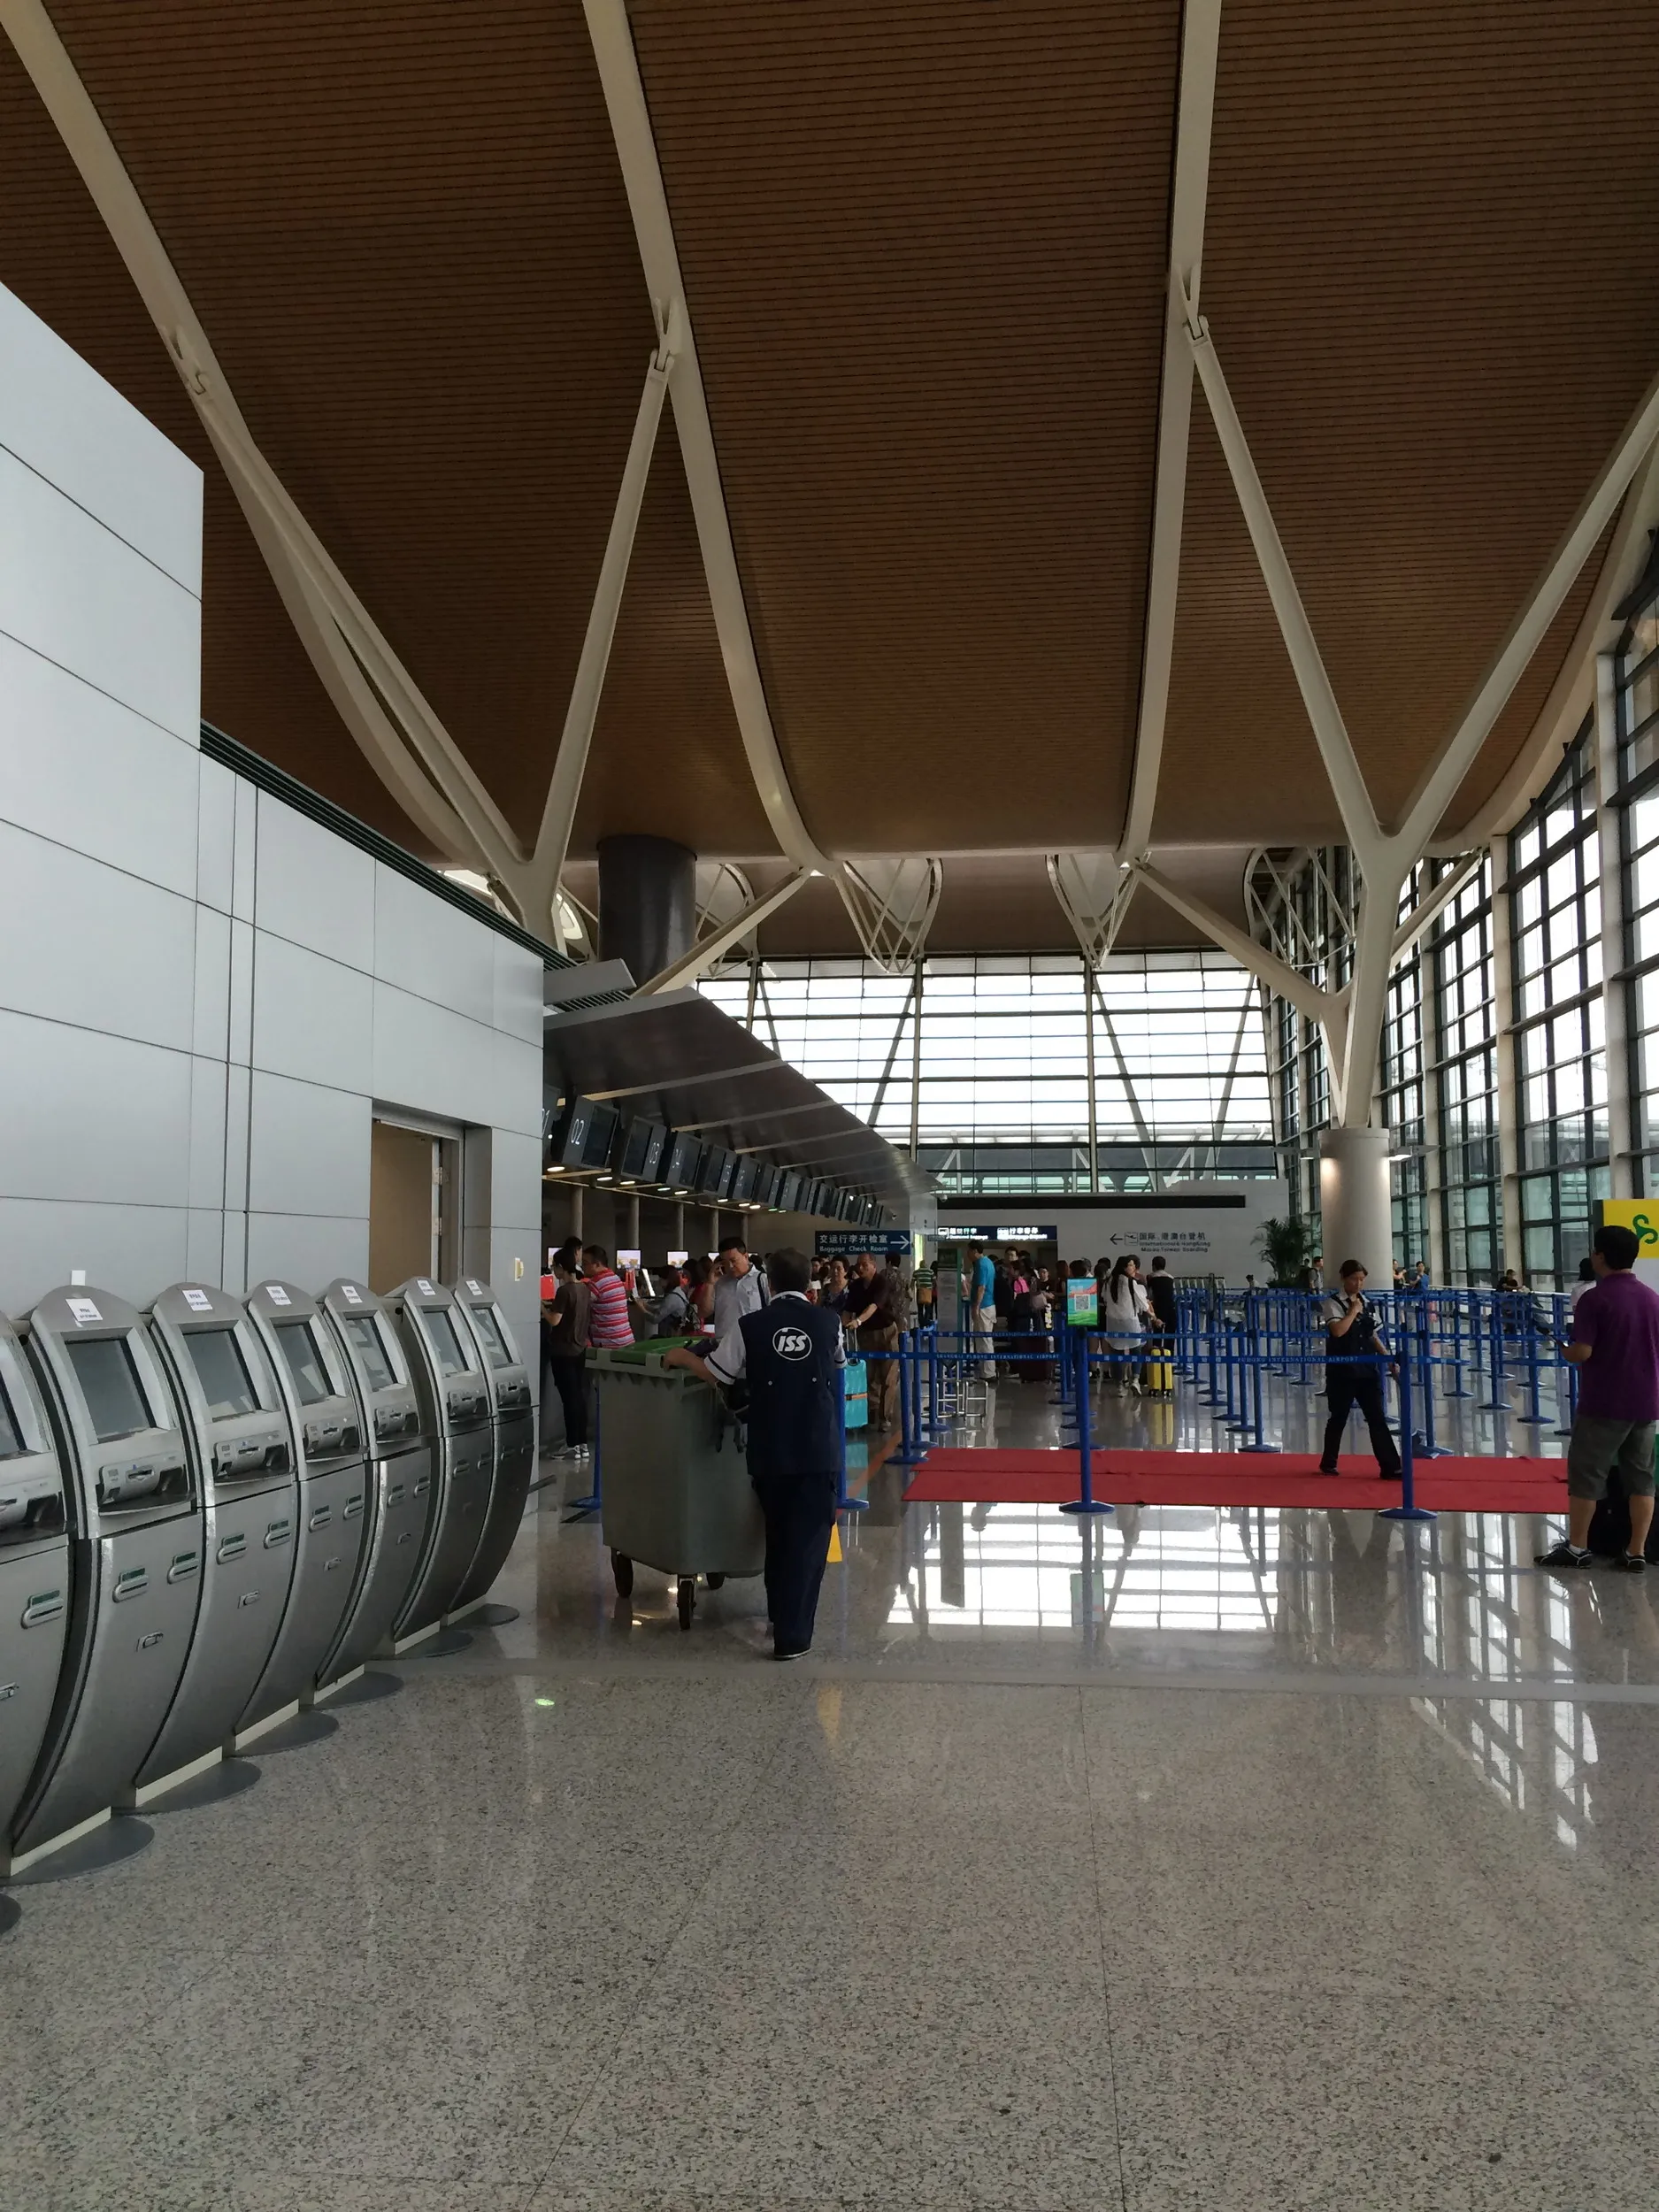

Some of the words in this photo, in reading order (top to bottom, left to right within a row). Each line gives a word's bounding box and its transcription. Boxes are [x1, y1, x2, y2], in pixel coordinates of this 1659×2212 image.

[571, 1118, 584, 1145] 02
[649, 1142, 660, 1164] 03
[819, 1234, 887, 1244] 交运行李开检室
